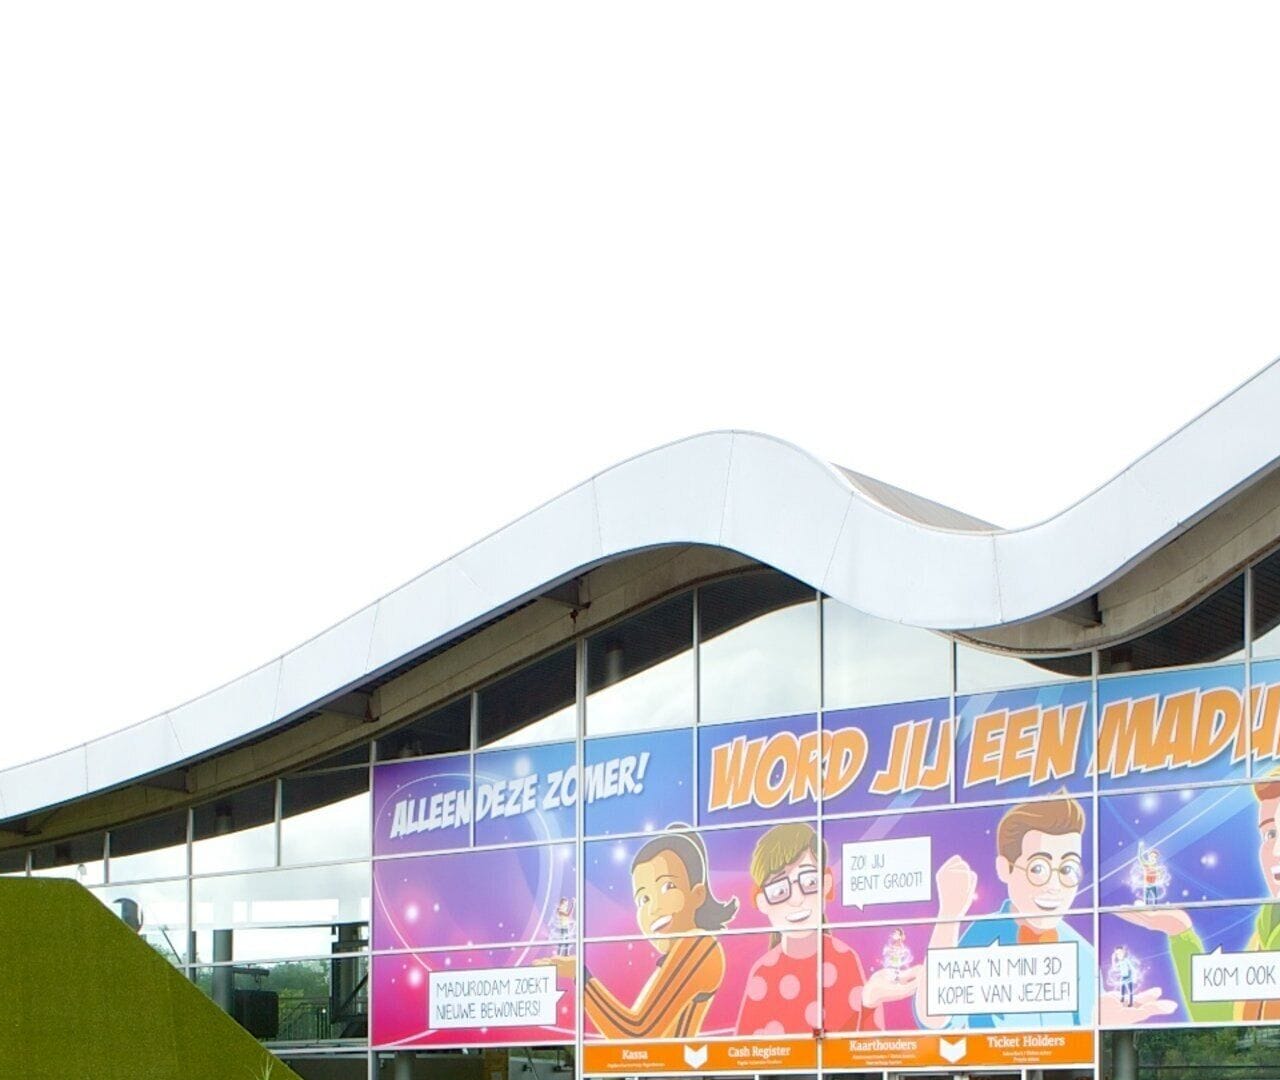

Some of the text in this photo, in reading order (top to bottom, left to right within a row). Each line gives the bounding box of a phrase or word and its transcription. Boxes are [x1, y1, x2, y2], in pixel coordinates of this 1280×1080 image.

[708, 726, 869, 813] WORD
[869, 716, 960, 795] JIJ
[963, 701, 1088, 789] EEN
[389, 752, 651, 839] ALLEEN DEZE ZOMER!
[850, 870, 923, 892] BENT GROOT!
[937, 959, 982, 980] MAAK
[1007, 956, 1038, 977] MINI
[1043, 956, 1062, 976] 3D
[1203, 966, 1240, 987] KOM
[1246, 964, 1277, 986] OOK
[436, 976, 550, 998] MADURODAM ZOEKT
[937, 981, 1071, 1006] KOPIE VAN JEZELF!
[436, 1000, 541, 1021] NIEUWE BEWONERS!
[728, 1045, 791, 1059] Cash Register
[849, 1039, 917, 1051] Kaarthouders
[987, 1035, 1066, 1048] Ticket Holders
[622, 1049, 648, 1060] Kassa
